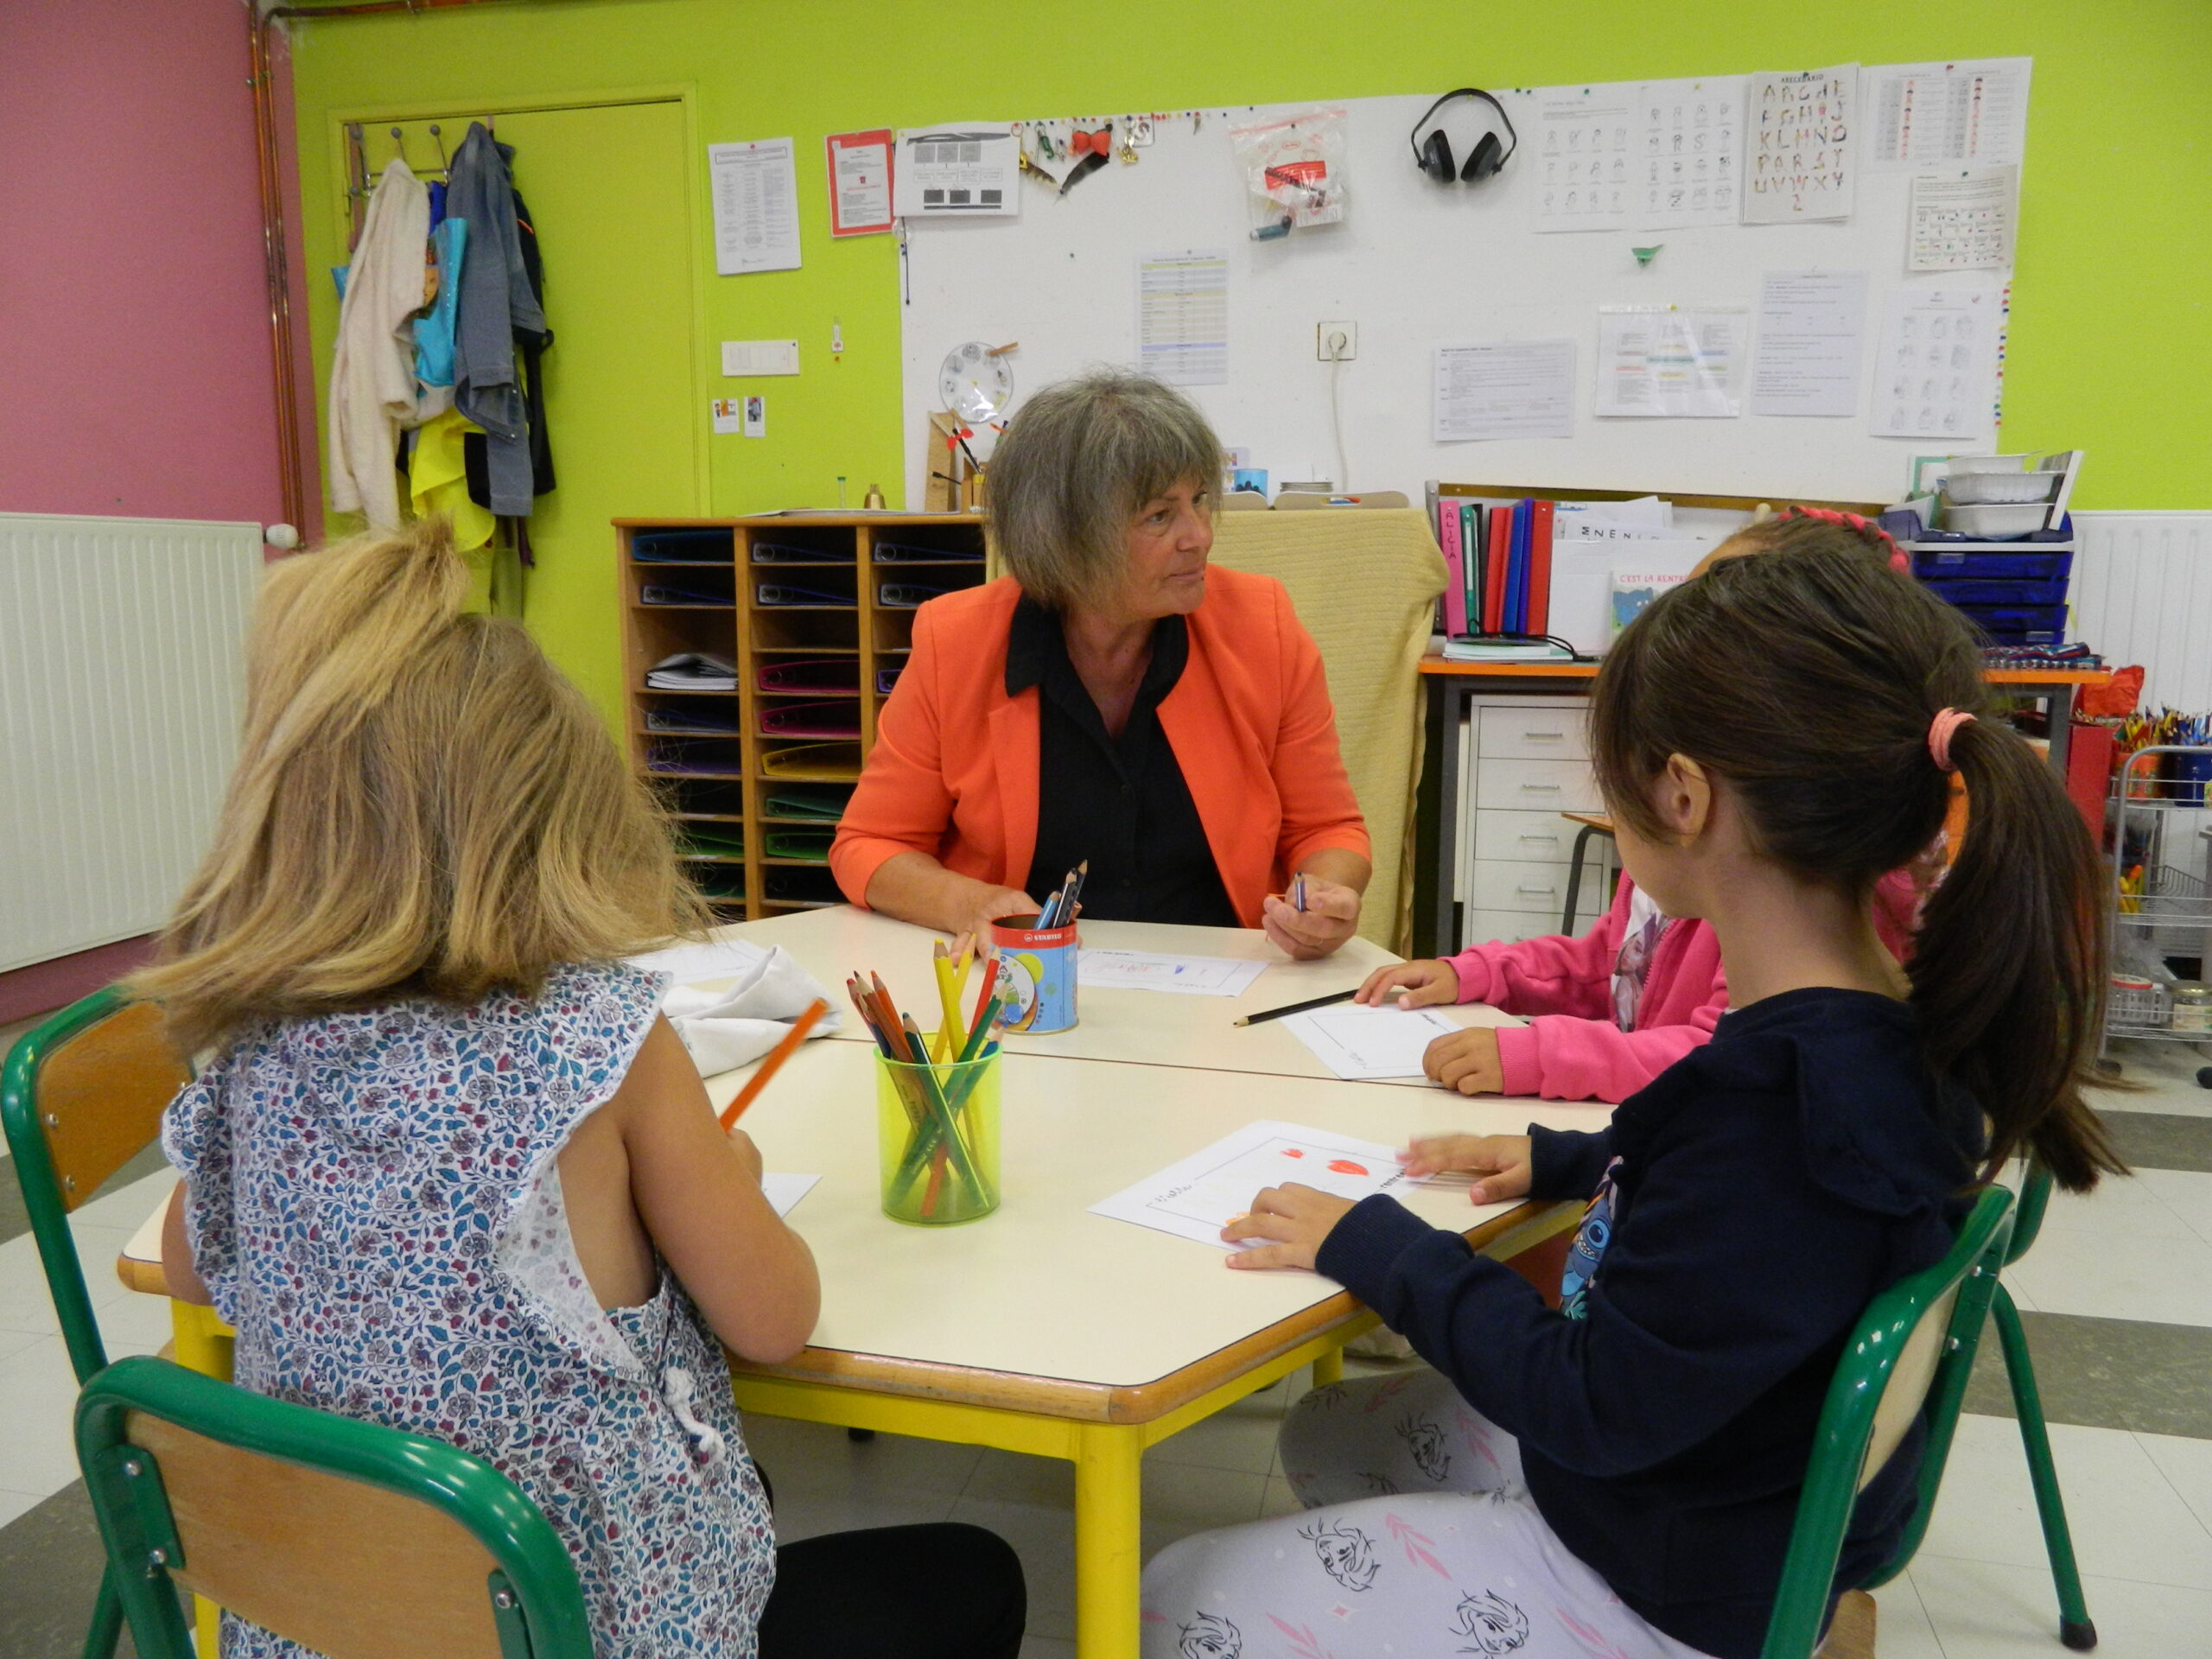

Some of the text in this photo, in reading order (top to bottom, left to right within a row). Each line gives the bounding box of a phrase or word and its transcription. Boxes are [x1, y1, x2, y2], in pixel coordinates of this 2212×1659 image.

[1446, 512, 1457, 559] ALICIA
[1619, 574, 1641, 582] C'EST
[1644, 574, 1654, 582] LA
